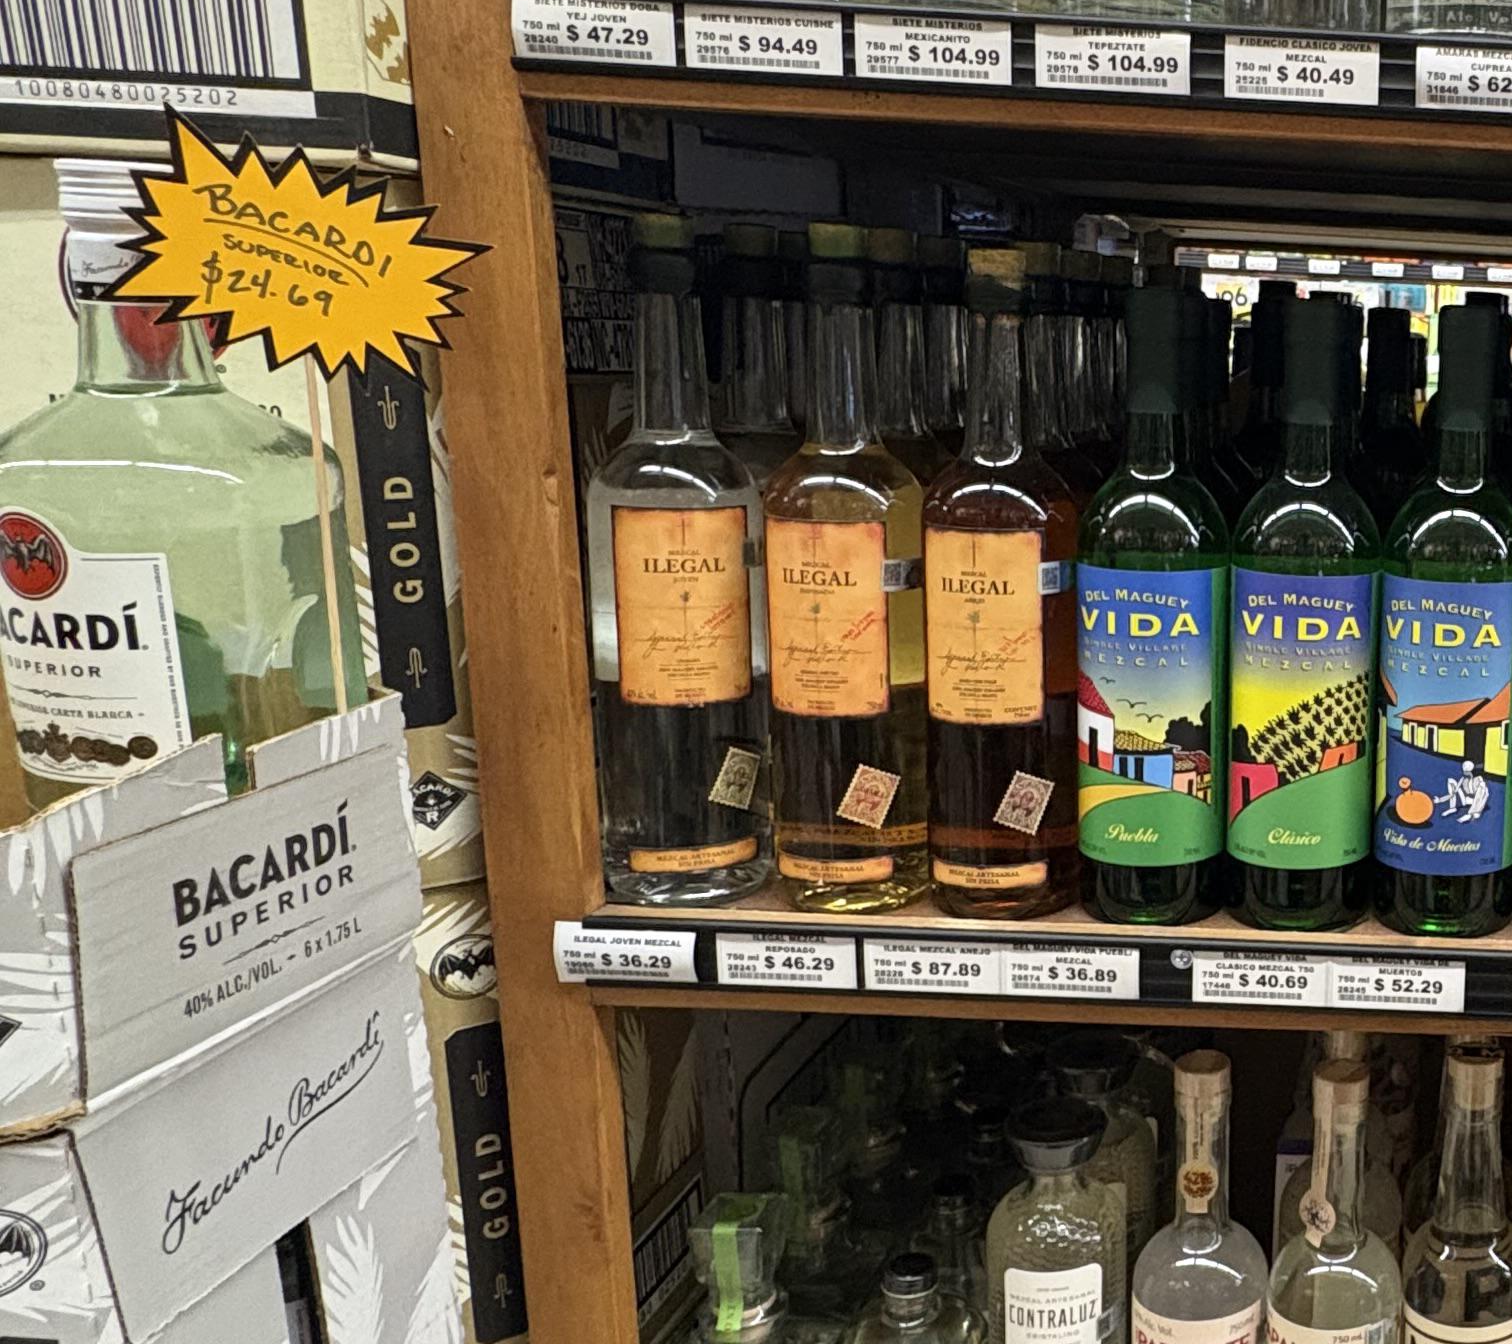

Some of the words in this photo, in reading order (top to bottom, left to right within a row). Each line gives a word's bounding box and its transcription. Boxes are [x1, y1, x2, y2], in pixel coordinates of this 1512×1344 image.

[566, 23, 580, 42] $
[583, 25, 648, 45] 47.29
[1089, 41, 1146, 53] TEPEZTATE
[1286, 53, 1327, 64] MEZCAL
[15, 77, 238, 108] 10080480025202
[1468, 74, 1480, 94] $
[194, 185, 392, 277] BACARDI
[222, 232, 350, 286] SUPERIOR
[201, 251, 334, 317] $24.69
[384, 475, 425, 604] GOLD
[642, 557, 726, 575] ILEGAL
[782, 567, 857, 587] ILEGAL
[940, 577, 1015, 596] ILEGAL
[1085, 589, 1111, 602] DEL
[1114, 589, 1189, 608] MAGUEY
[1248, 594, 1277, 607] DEL
[1283, 594, 1354, 613] MAGUEY
[1391, 599, 1418, 612] DEL
[1421, 599, 1494, 621] MAGUEY
[1081, 606, 1200, 638] VIDA
[1241, 610, 1361, 642] VIDA
[1386, 615, 1501, 648] VIDA
[170, 799, 352, 927] BACARDÍ
[178, 864, 355, 961] SUPERIOR
[184, 990, 214, 1018] 40%
[216, 962, 282, 1004] ALC./VOL.
[304, 939, 313, 956] 6
[326, 923, 352, 950] 1.75
[601, 953, 612, 968] $
[619, 953, 672, 969] 36.29
[1239, 970, 1249, 987] $
[1254, 974, 1308, 990] 40.69
[161, 1118, 286, 1256] Facundo
[287, 1010, 385, 1129] Bacardí
[481, 1131, 515, 1240] GOLD
[1008, 1300, 1098, 1330] CONTRALUZ
